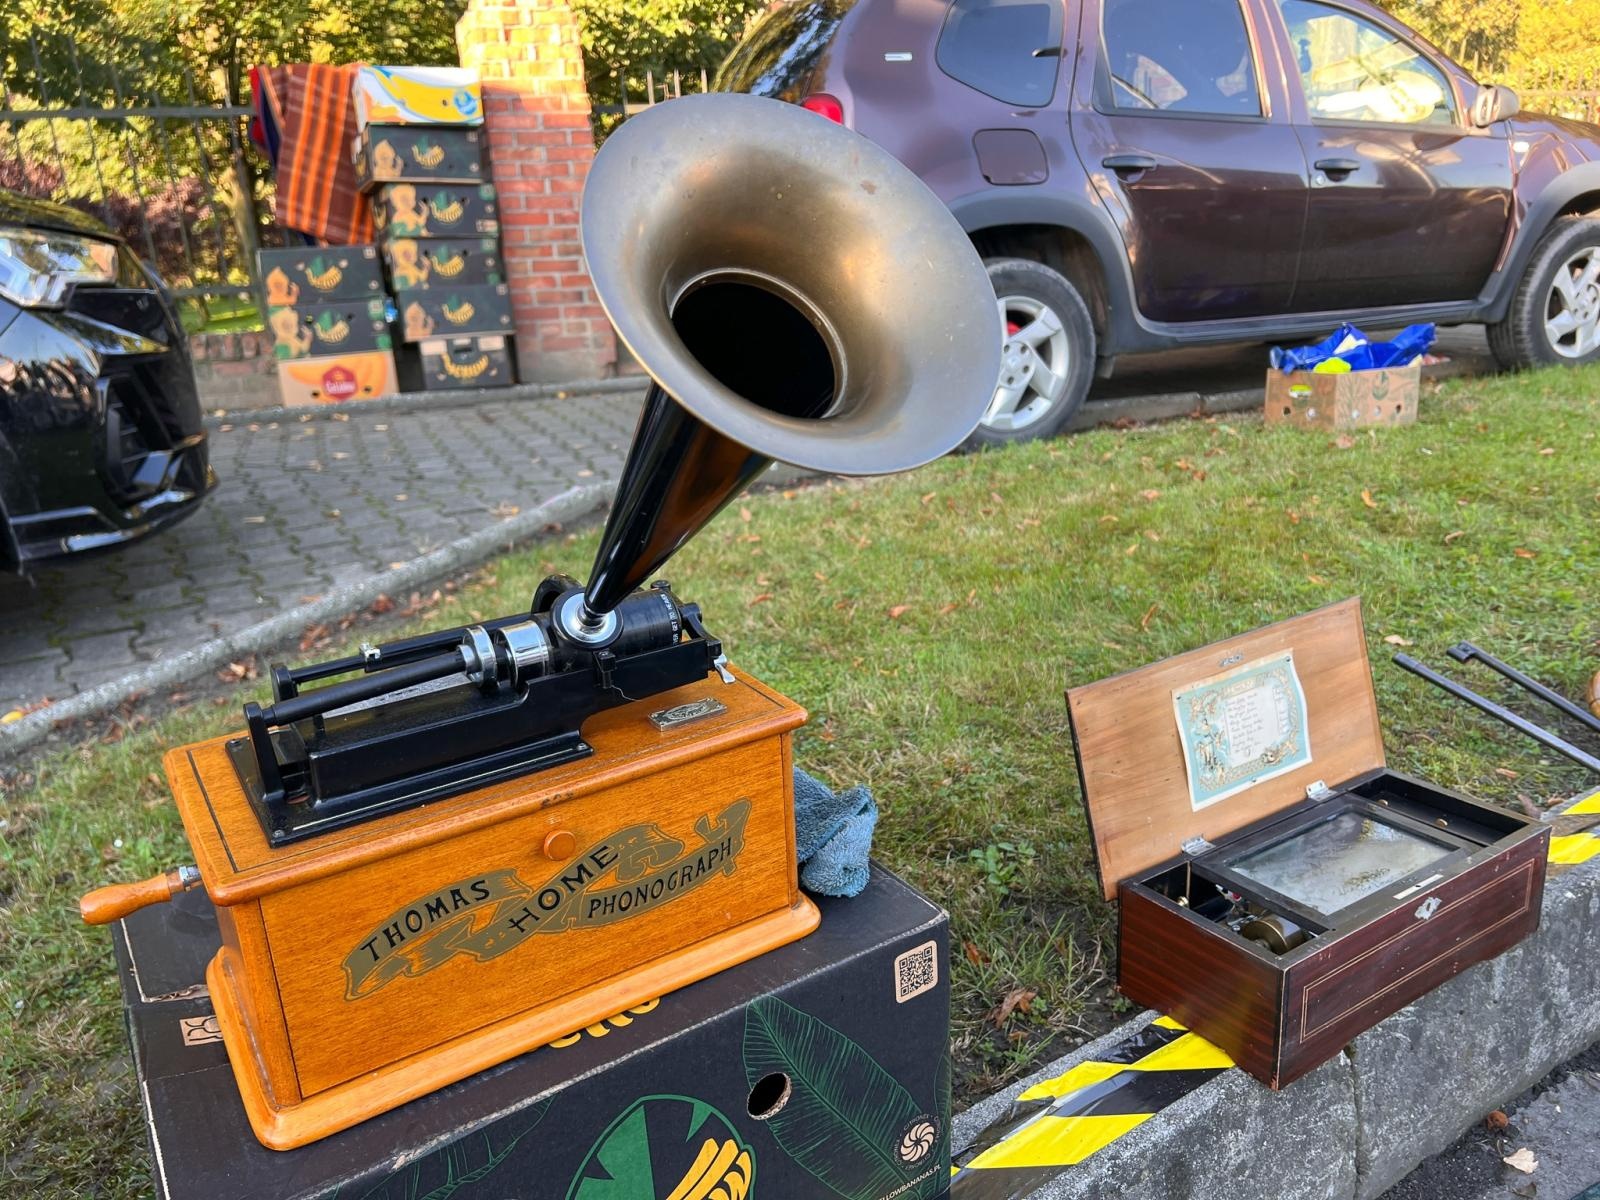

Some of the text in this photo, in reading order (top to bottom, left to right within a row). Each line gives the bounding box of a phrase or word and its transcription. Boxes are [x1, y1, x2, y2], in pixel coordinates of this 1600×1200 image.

[361, 837, 732, 962] THOMAS HOME PHONOGRAPH
